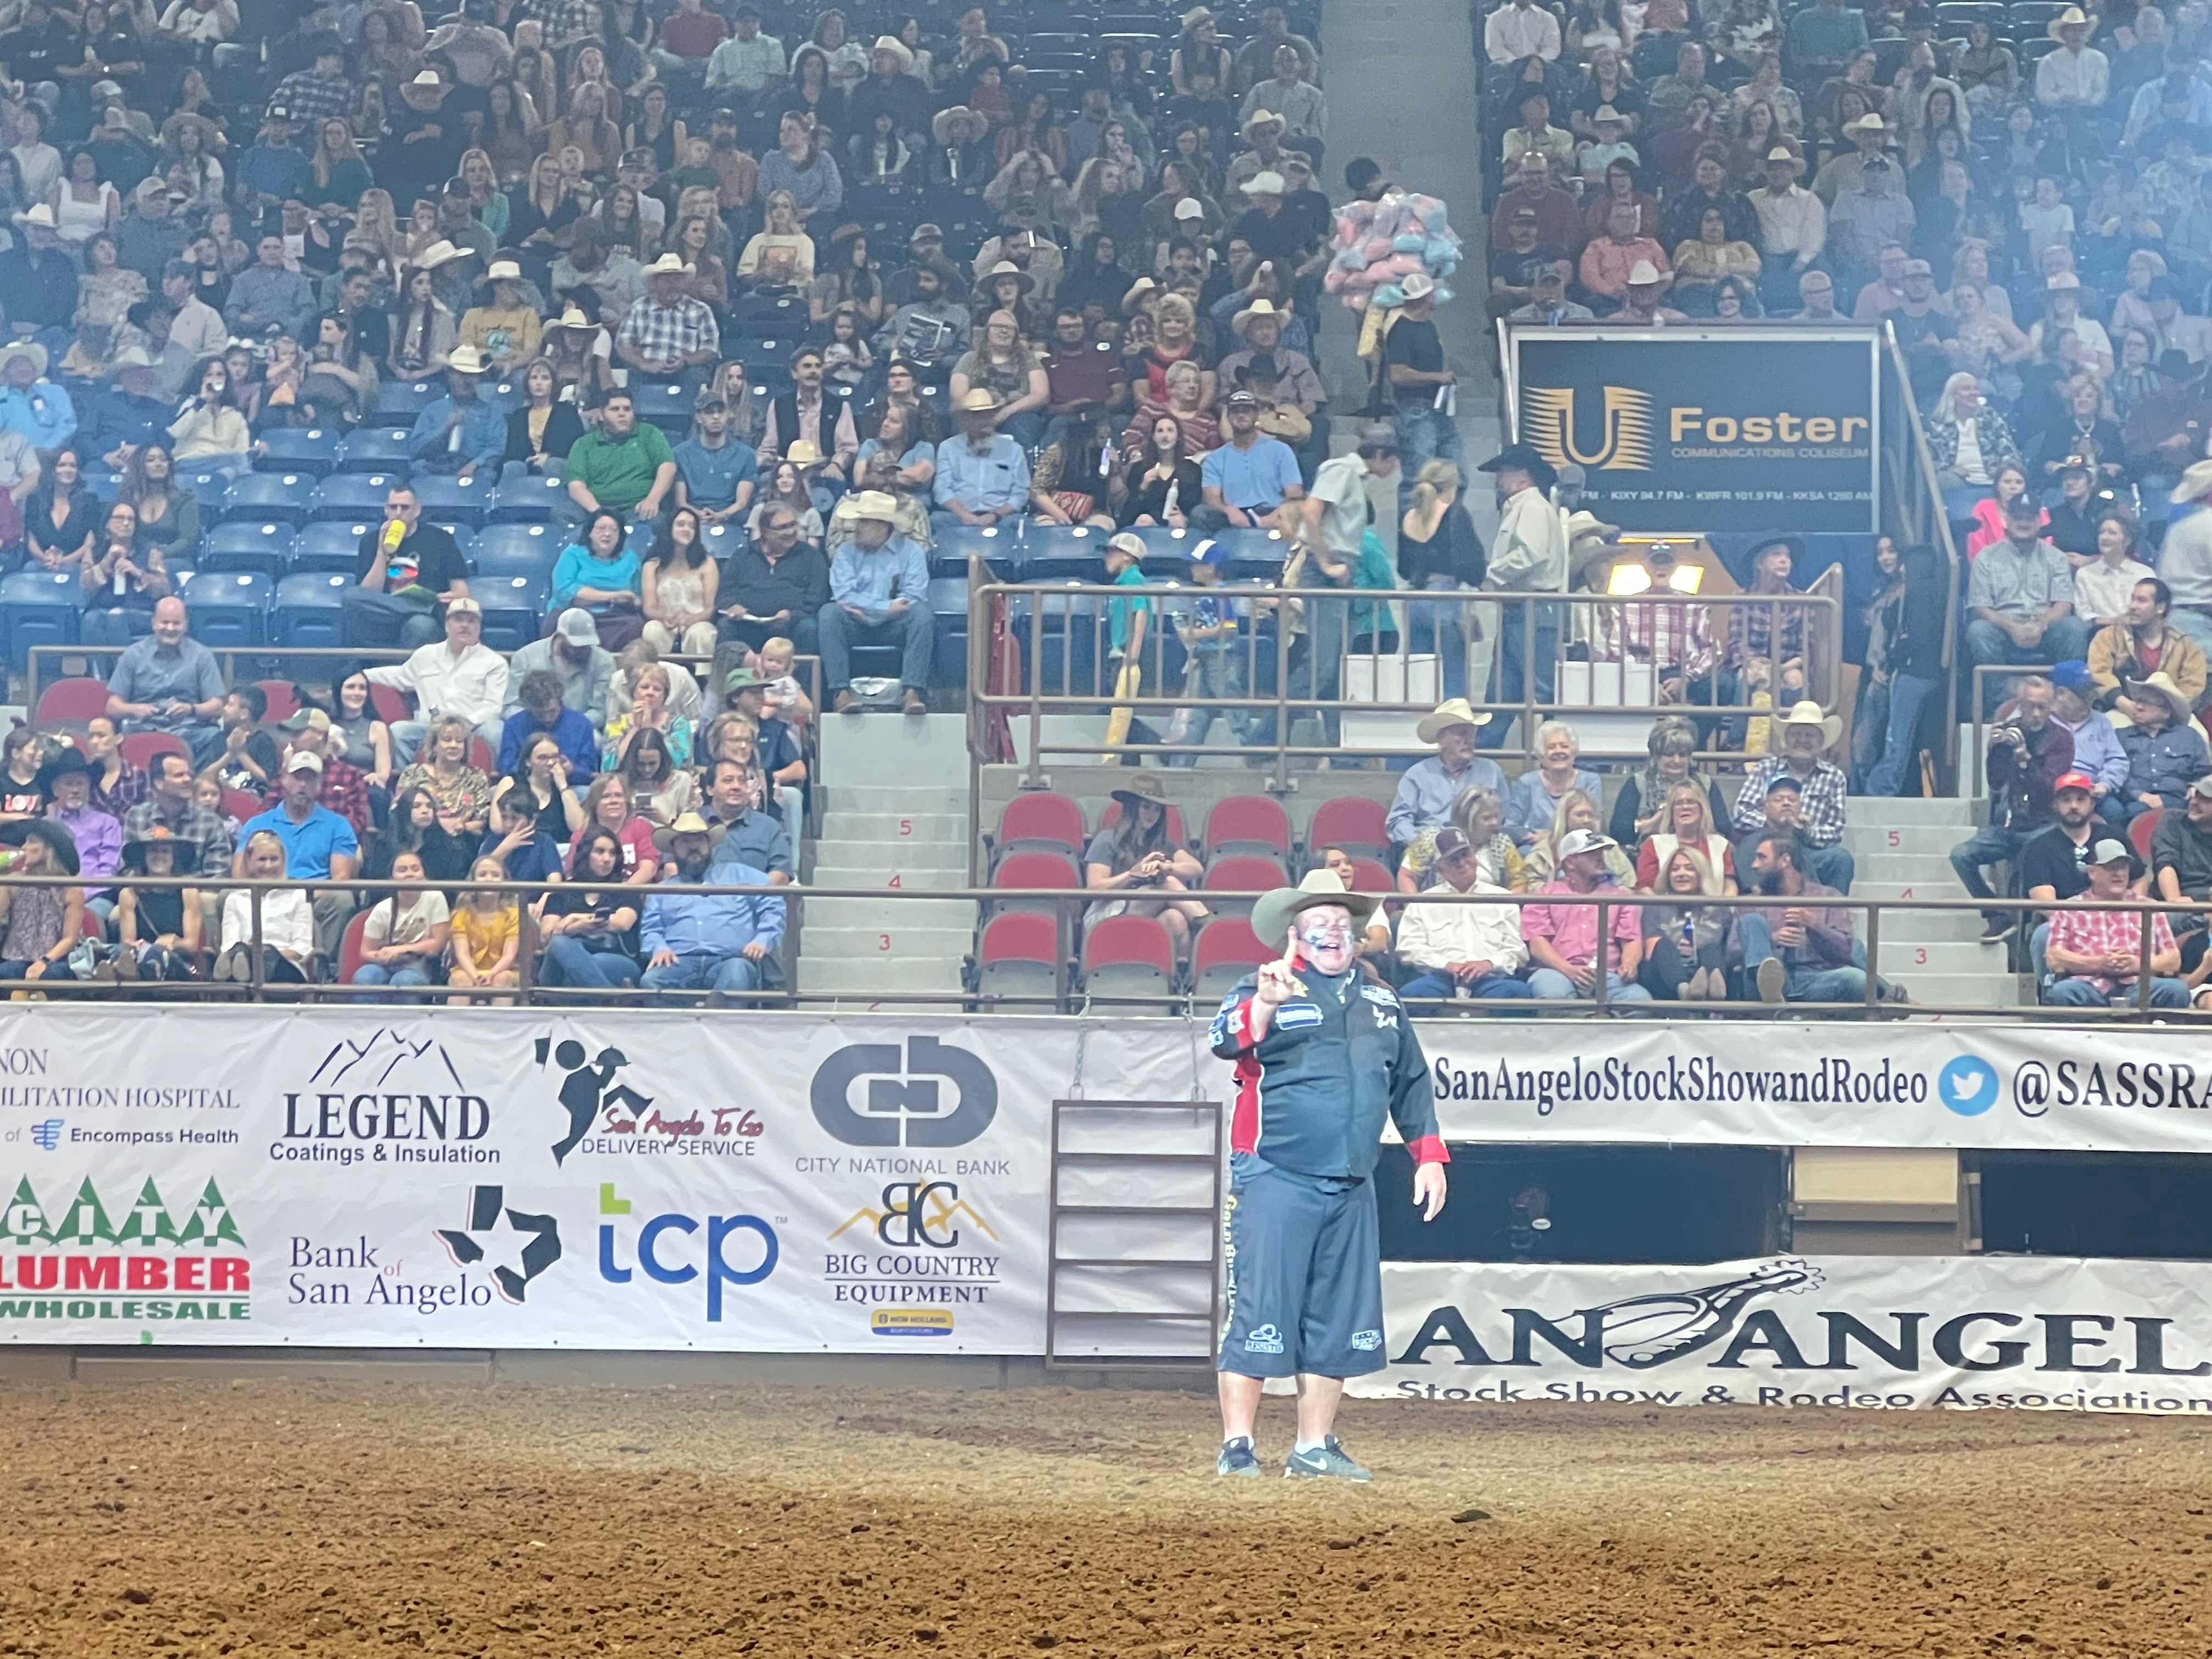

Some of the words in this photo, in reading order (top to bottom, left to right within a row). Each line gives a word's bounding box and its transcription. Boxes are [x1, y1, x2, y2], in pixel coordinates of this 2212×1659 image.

[1671, 407, 1868, 442] Foster
[1672, 447, 1796, 458] COMMUNICATIONS
[1799, 447, 1869, 458] COLISEUM
[900, 820, 912, 836] 5
[1888, 831, 1900, 847] 5
[879, 934, 891, 951] 3
[1915, 948, 1927, 965] 3
[1435, 1054, 1928, 1117] SanAngeloStockShowandRodeo
[126, 1088, 240, 1109] HOSPITAL
[283, 1093, 490, 1140] LEGEND
[5, 1128, 22, 1142] of
[71, 1128, 173, 1146] Encompass
[179, 1129, 239, 1144] Health
[601, 1108, 637, 1137] San
[644, 1109, 704, 1148] Angelo
[711, 1108, 731, 1136] To
[737, 1110, 764, 1137] Go
[269, 1143, 364, 1165] Coatings
[373, 1144, 388, 1162] &
[394, 1144, 500, 1164] Insulation
[582, 1138, 675, 1155] DELIVERY
[678, 1140, 755, 1156] SERVICE
[795, 1157, 841, 1174] CITY
[849, 1158, 948, 1175] NATIONAL
[956, 1159, 1011, 1176] BANK
[8, 1204, 226, 1237] CITY
[290, 1235, 380, 1269] Bank
[384, 1260, 404, 1278] of
[825, 1255, 867, 1275] BIG
[877, 1255, 1000, 1276] COUNTRY
[287, 1273, 351, 1305] San
[365, 1273, 492, 1315] Angelo
[834, 1285, 989, 1305] EQUIPMENT
[0, 1301, 251, 1320] WHOLESALE
[1397, 1380, 1525, 1403] Stock
[1547, 1381, 1683, 1406] Show
[1701, 1385, 1736, 1404] &
[1758, 1386, 1915, 1409] Rodeo
[1932, 1386, 2212, 1413] Association
